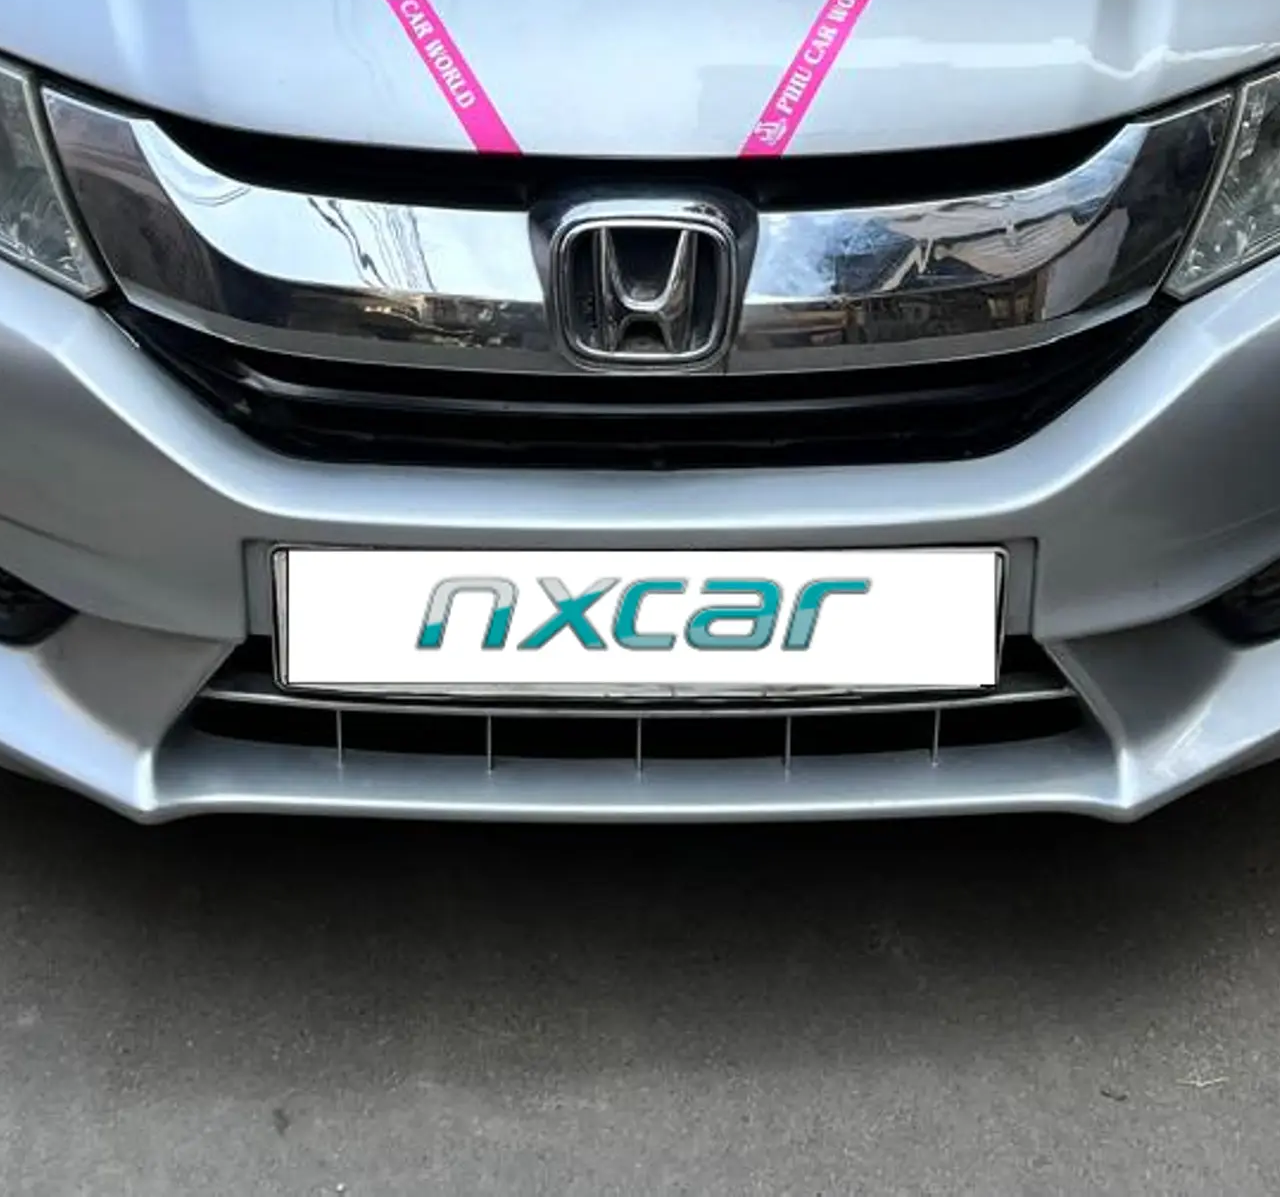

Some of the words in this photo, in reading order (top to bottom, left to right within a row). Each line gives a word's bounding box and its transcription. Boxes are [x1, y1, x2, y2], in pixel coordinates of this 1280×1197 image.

[400, 0, 435, 39] CAR
[423, 39, 477, 109] WORLD
[803, 23, 839, 66] CAR
